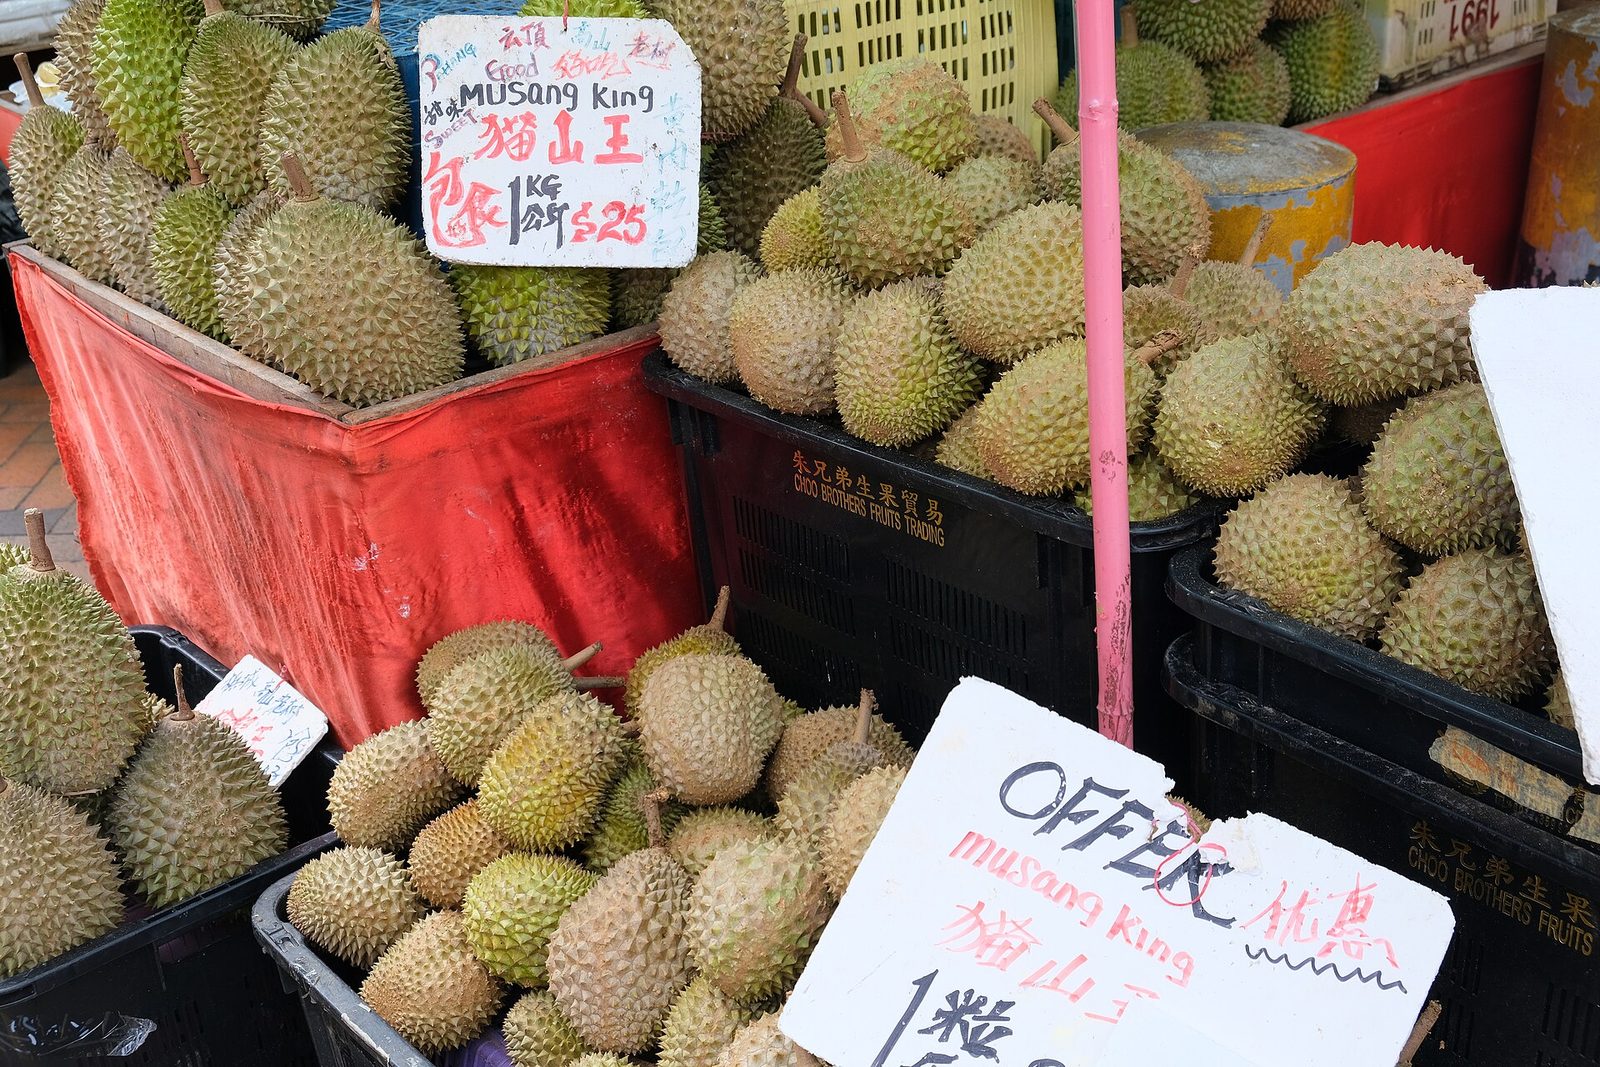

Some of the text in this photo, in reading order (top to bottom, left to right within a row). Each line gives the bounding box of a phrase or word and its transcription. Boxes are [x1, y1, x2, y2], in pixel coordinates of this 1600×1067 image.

[485, 52, 540, 82] Good
[473, 110, 645, 165] 猫山王
[526, 174, 563, 201] KG
[570, 201, 647, 246] $25
[793, 450, 944, 526] 朱兄弟生果貿易
[794, 473, 945, 547] CHOO BROTHERS FRUITS TRADING
[949, 831, 1104, 928] musang
[1408, 846, 1593, 956] CHOO BROTHERS FRUITS
[1409, 820, 1597, 929] 朱兄弟生果
[1239, 871, 1400, 970] 优惠
